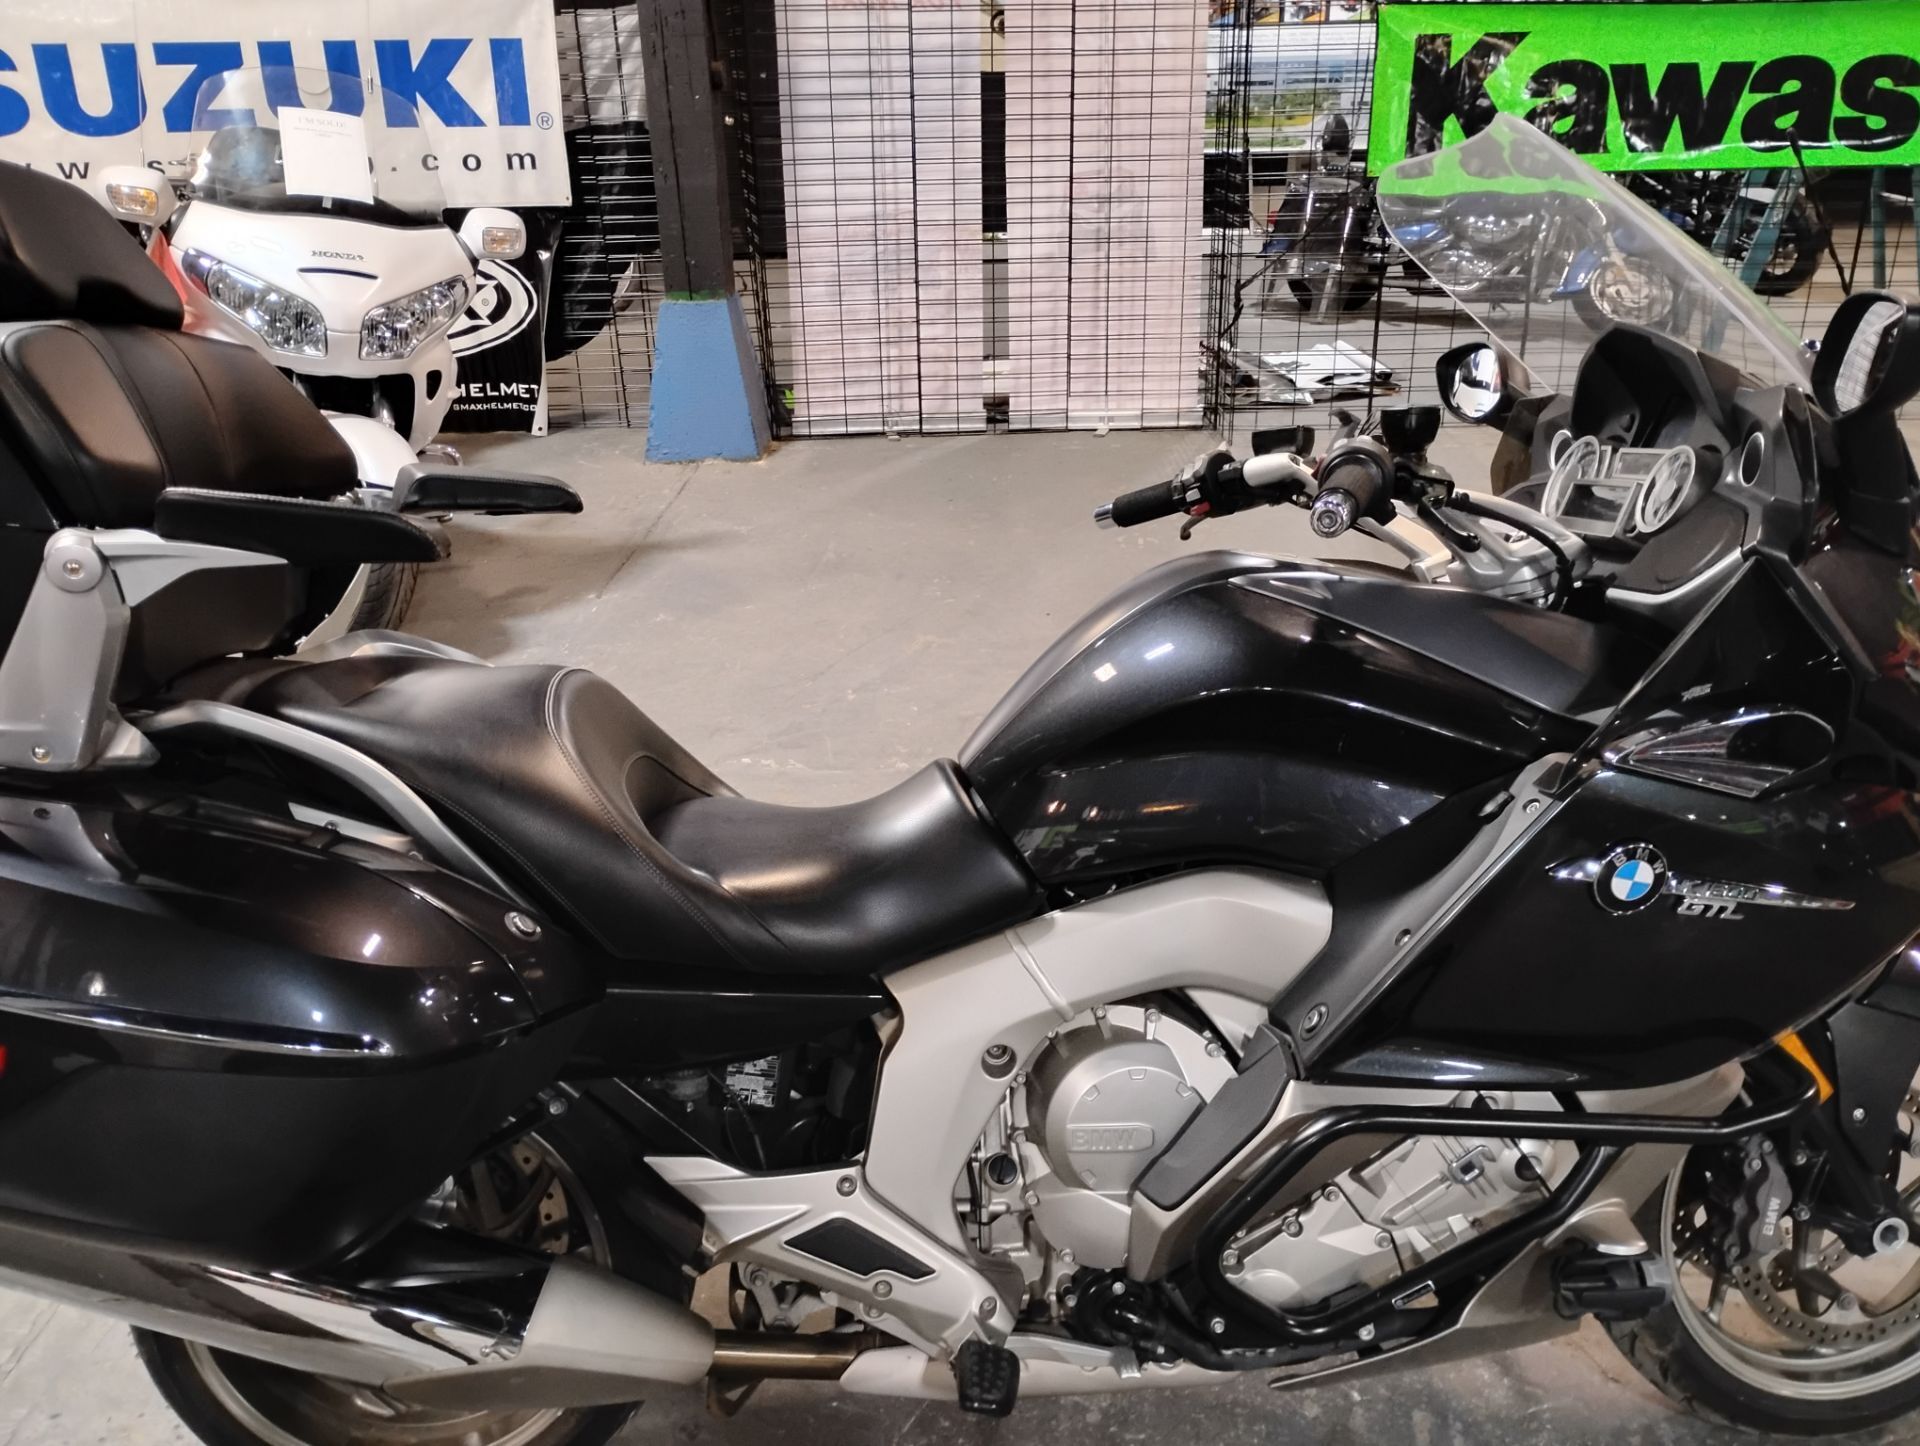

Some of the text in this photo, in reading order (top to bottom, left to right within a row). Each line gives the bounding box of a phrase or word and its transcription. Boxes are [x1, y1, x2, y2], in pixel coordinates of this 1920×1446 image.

[1397, 31, 1920, 177] Kawas
[311, 250, 366, 261] HONDA
[1677, 900, 1744, 920] GTL
[1071, 1128, 1137, 1151] BMW
[1762, 1197, 1782, 1235] BMW
